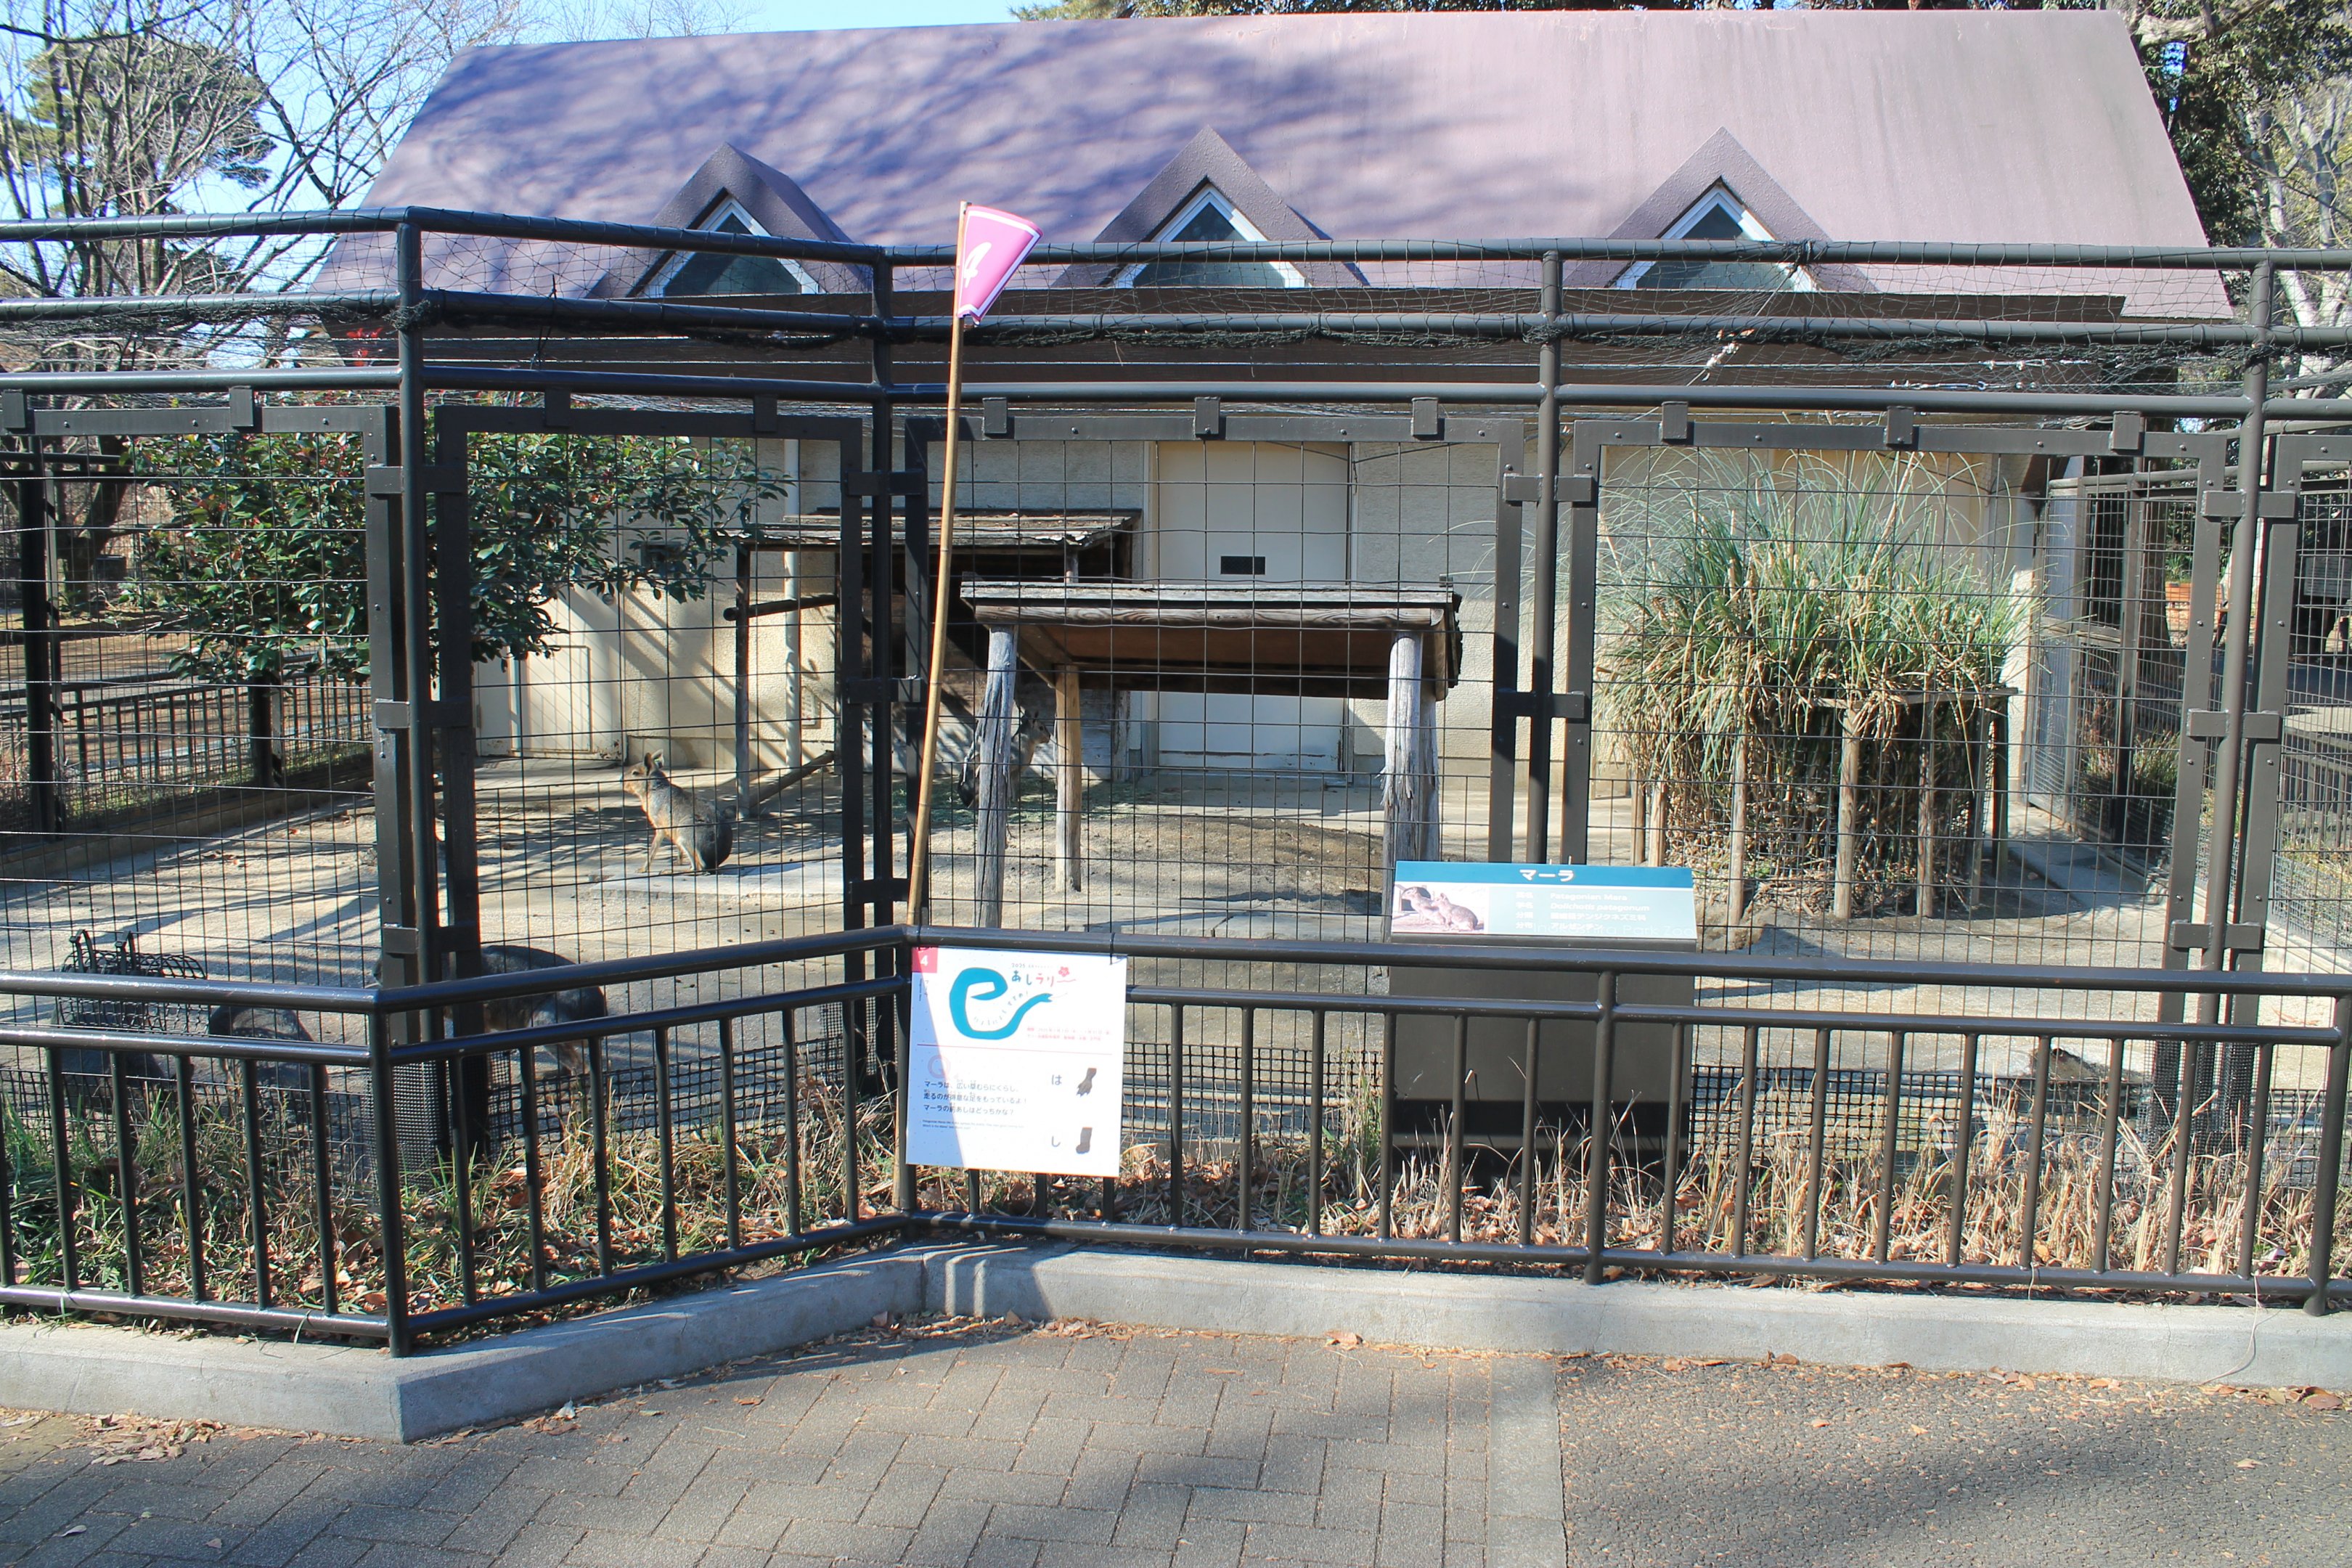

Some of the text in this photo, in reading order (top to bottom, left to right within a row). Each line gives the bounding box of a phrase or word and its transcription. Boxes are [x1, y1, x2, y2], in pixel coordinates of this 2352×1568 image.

[1519, 869, 1575, 882] マーラ
[1550, 892, 1601, 901] Patagonian
[920, 955, 928, 967] 4
[1051, 1074, 1062, 1085] は
[1051, 1136, 1061, 1148] し
